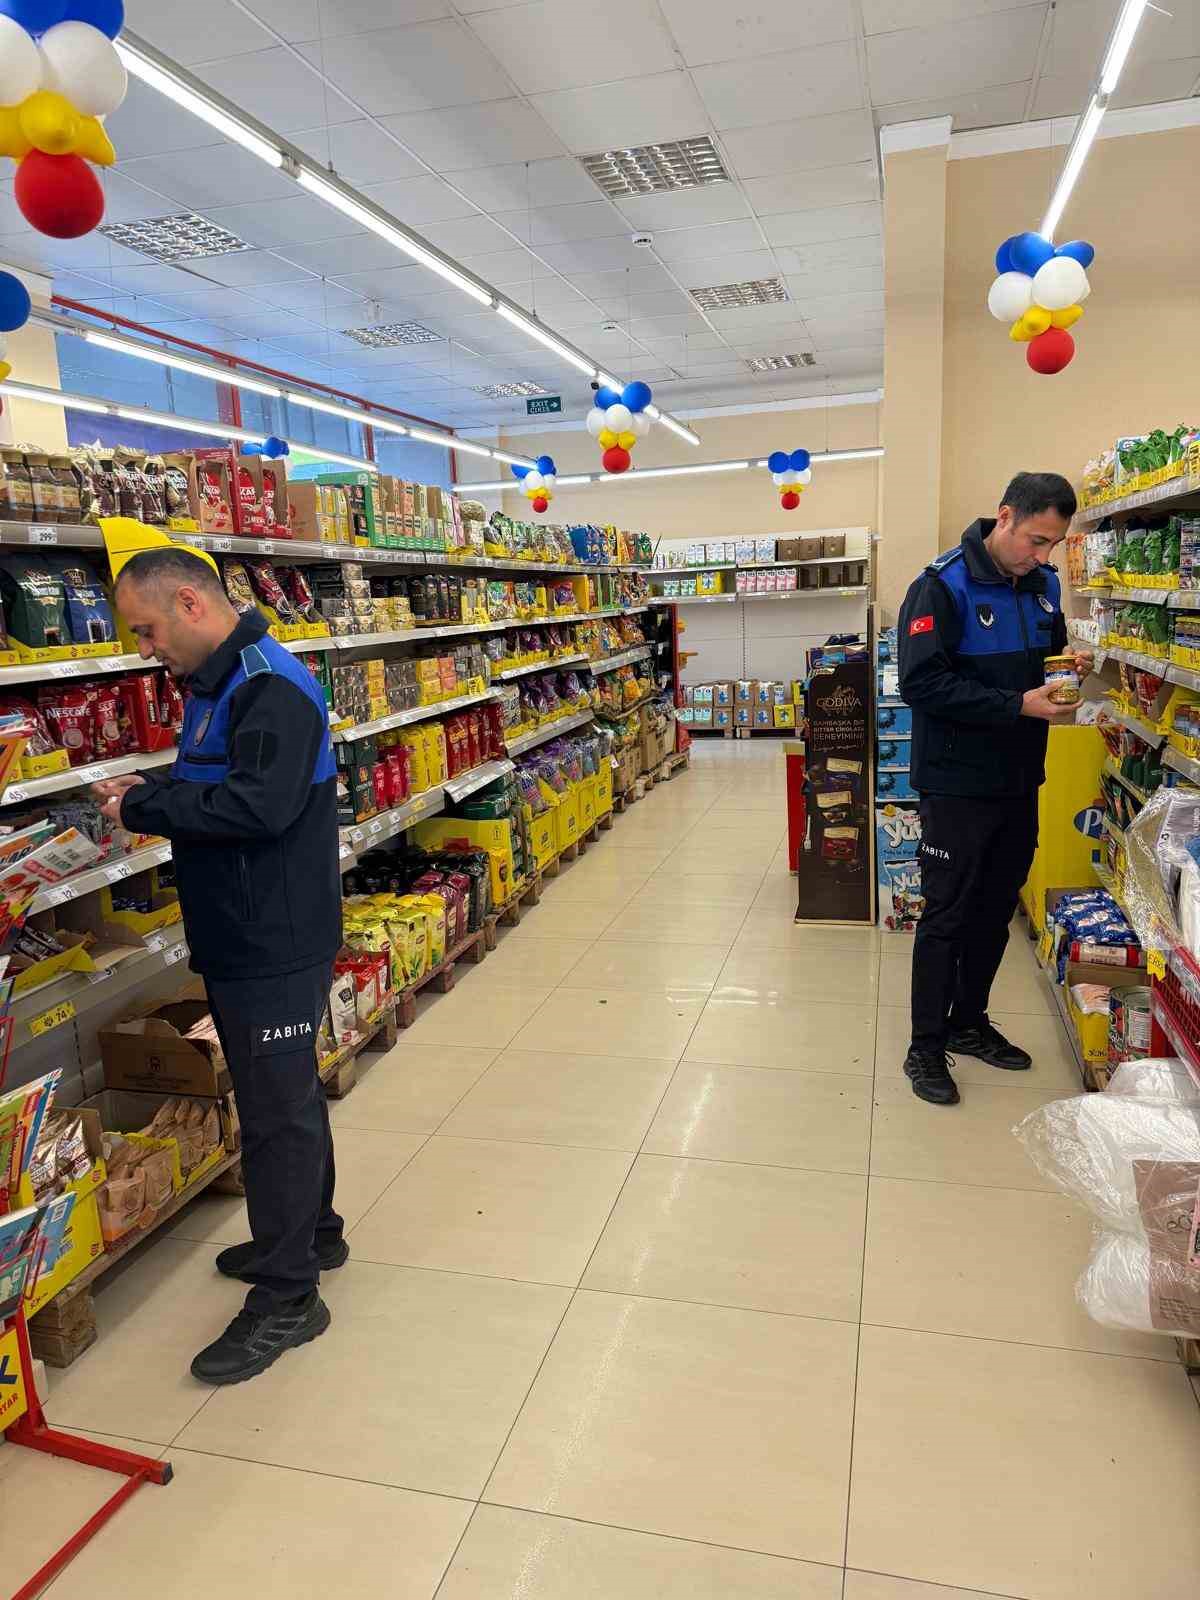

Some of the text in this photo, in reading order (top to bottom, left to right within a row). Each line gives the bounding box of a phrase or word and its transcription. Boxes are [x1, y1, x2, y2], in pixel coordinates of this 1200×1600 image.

[530, 400, 549, 408] EXIT
[816, 697, 863, 708] GODIVA
[920, 842, 950, 861] ZABITA
[261, 1021, 313, 1043] ZABITA
